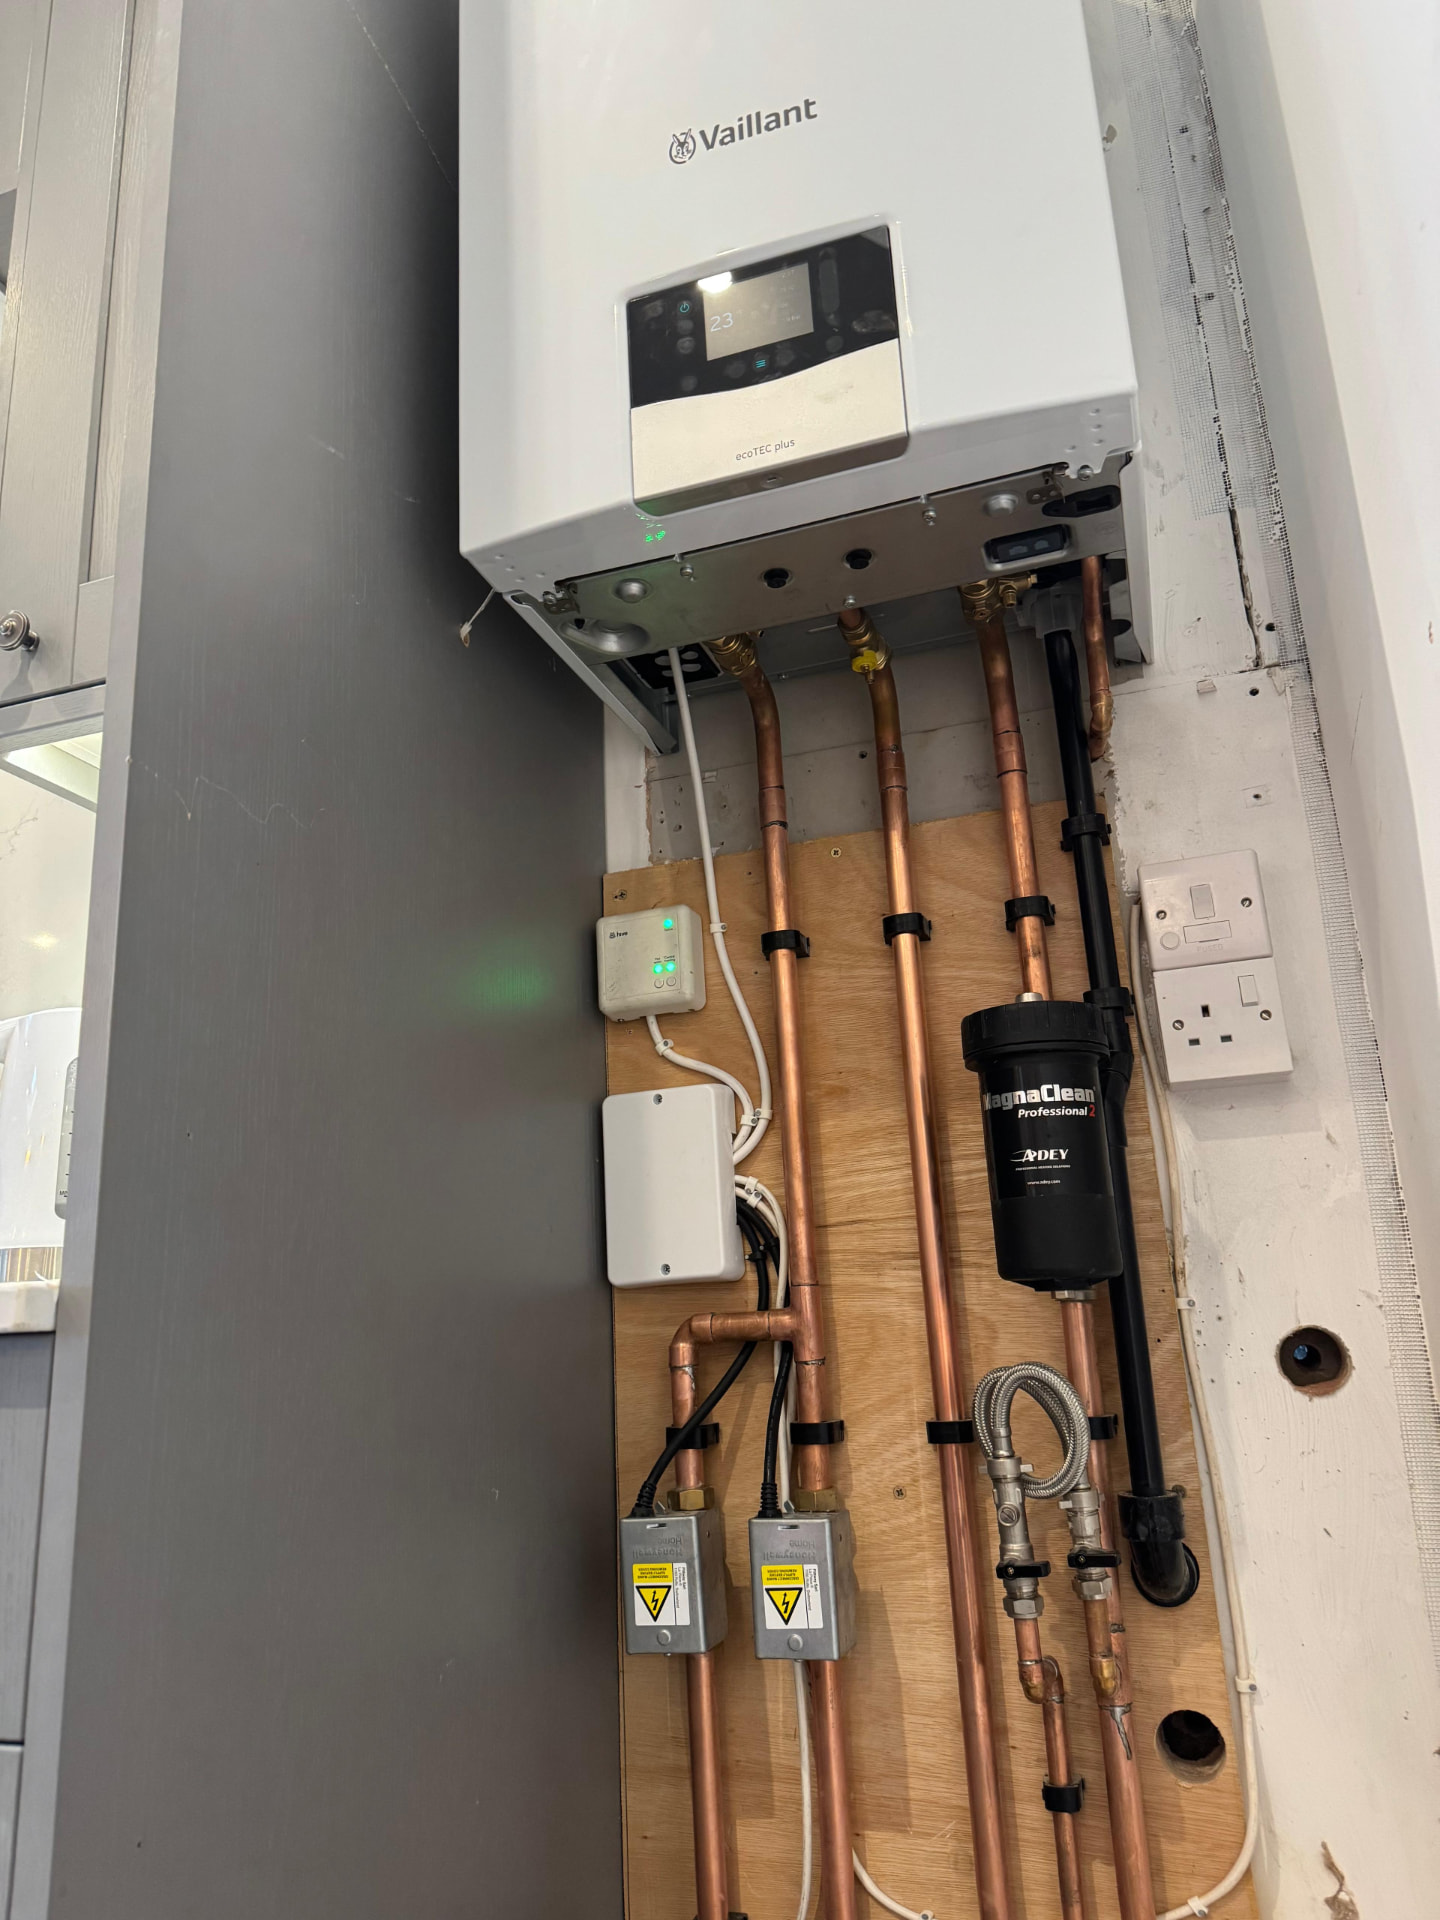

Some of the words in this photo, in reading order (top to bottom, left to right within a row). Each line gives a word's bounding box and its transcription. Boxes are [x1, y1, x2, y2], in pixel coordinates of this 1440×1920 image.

[699, 98, 818, 151] Vaillant
[710, 312, 734, 333] 23
[735, 444, 772, 461] ecoTEC
[774, 439, 795, 453] plus
[1018, 1106, 1088, 1119] Professional
[1089, 1104, 1096, 1117] 2
[1021, 1148, 1069, 1163] ADEY
